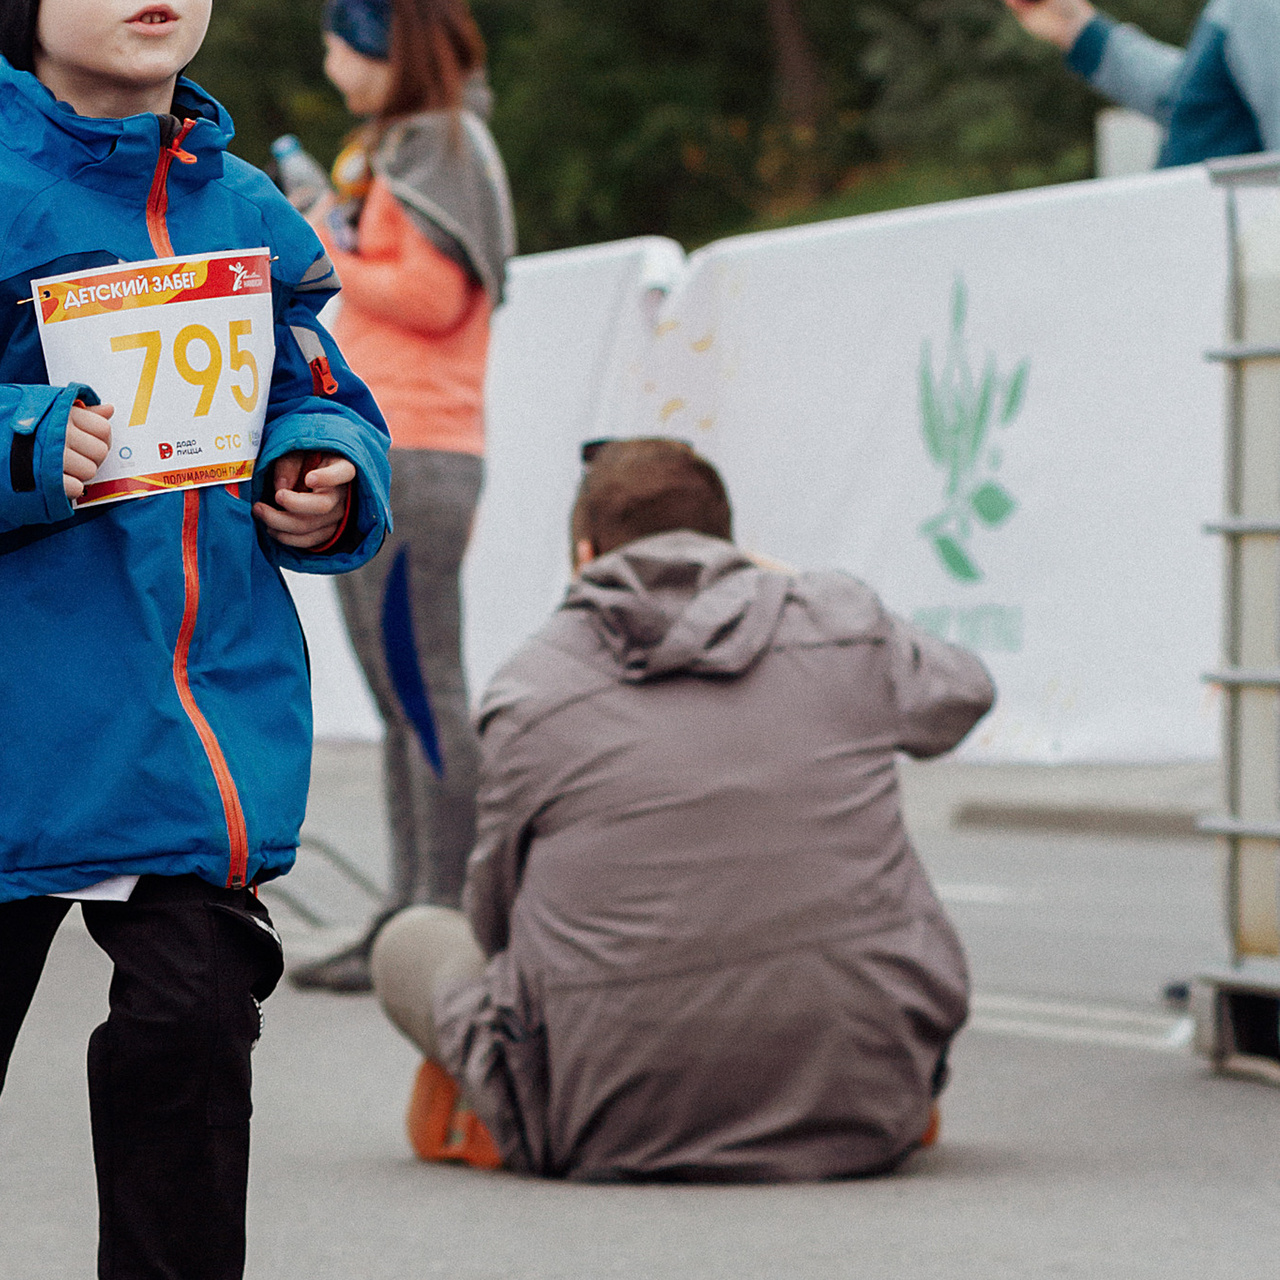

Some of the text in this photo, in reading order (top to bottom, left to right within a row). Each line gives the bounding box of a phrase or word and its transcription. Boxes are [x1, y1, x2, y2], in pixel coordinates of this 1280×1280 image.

[63, 272, 196, 310] ДЕТСКИЙ ЗАБЕГ
[110, 319, 259, 427] 795
[176, 439, 197, 449] ДОДО
[214, 434, 242, 450] СТС
[176, 447, 203, 457] ПИЦЦА
[163, 467, 227, 485] ПОЛУМАРАФОН
